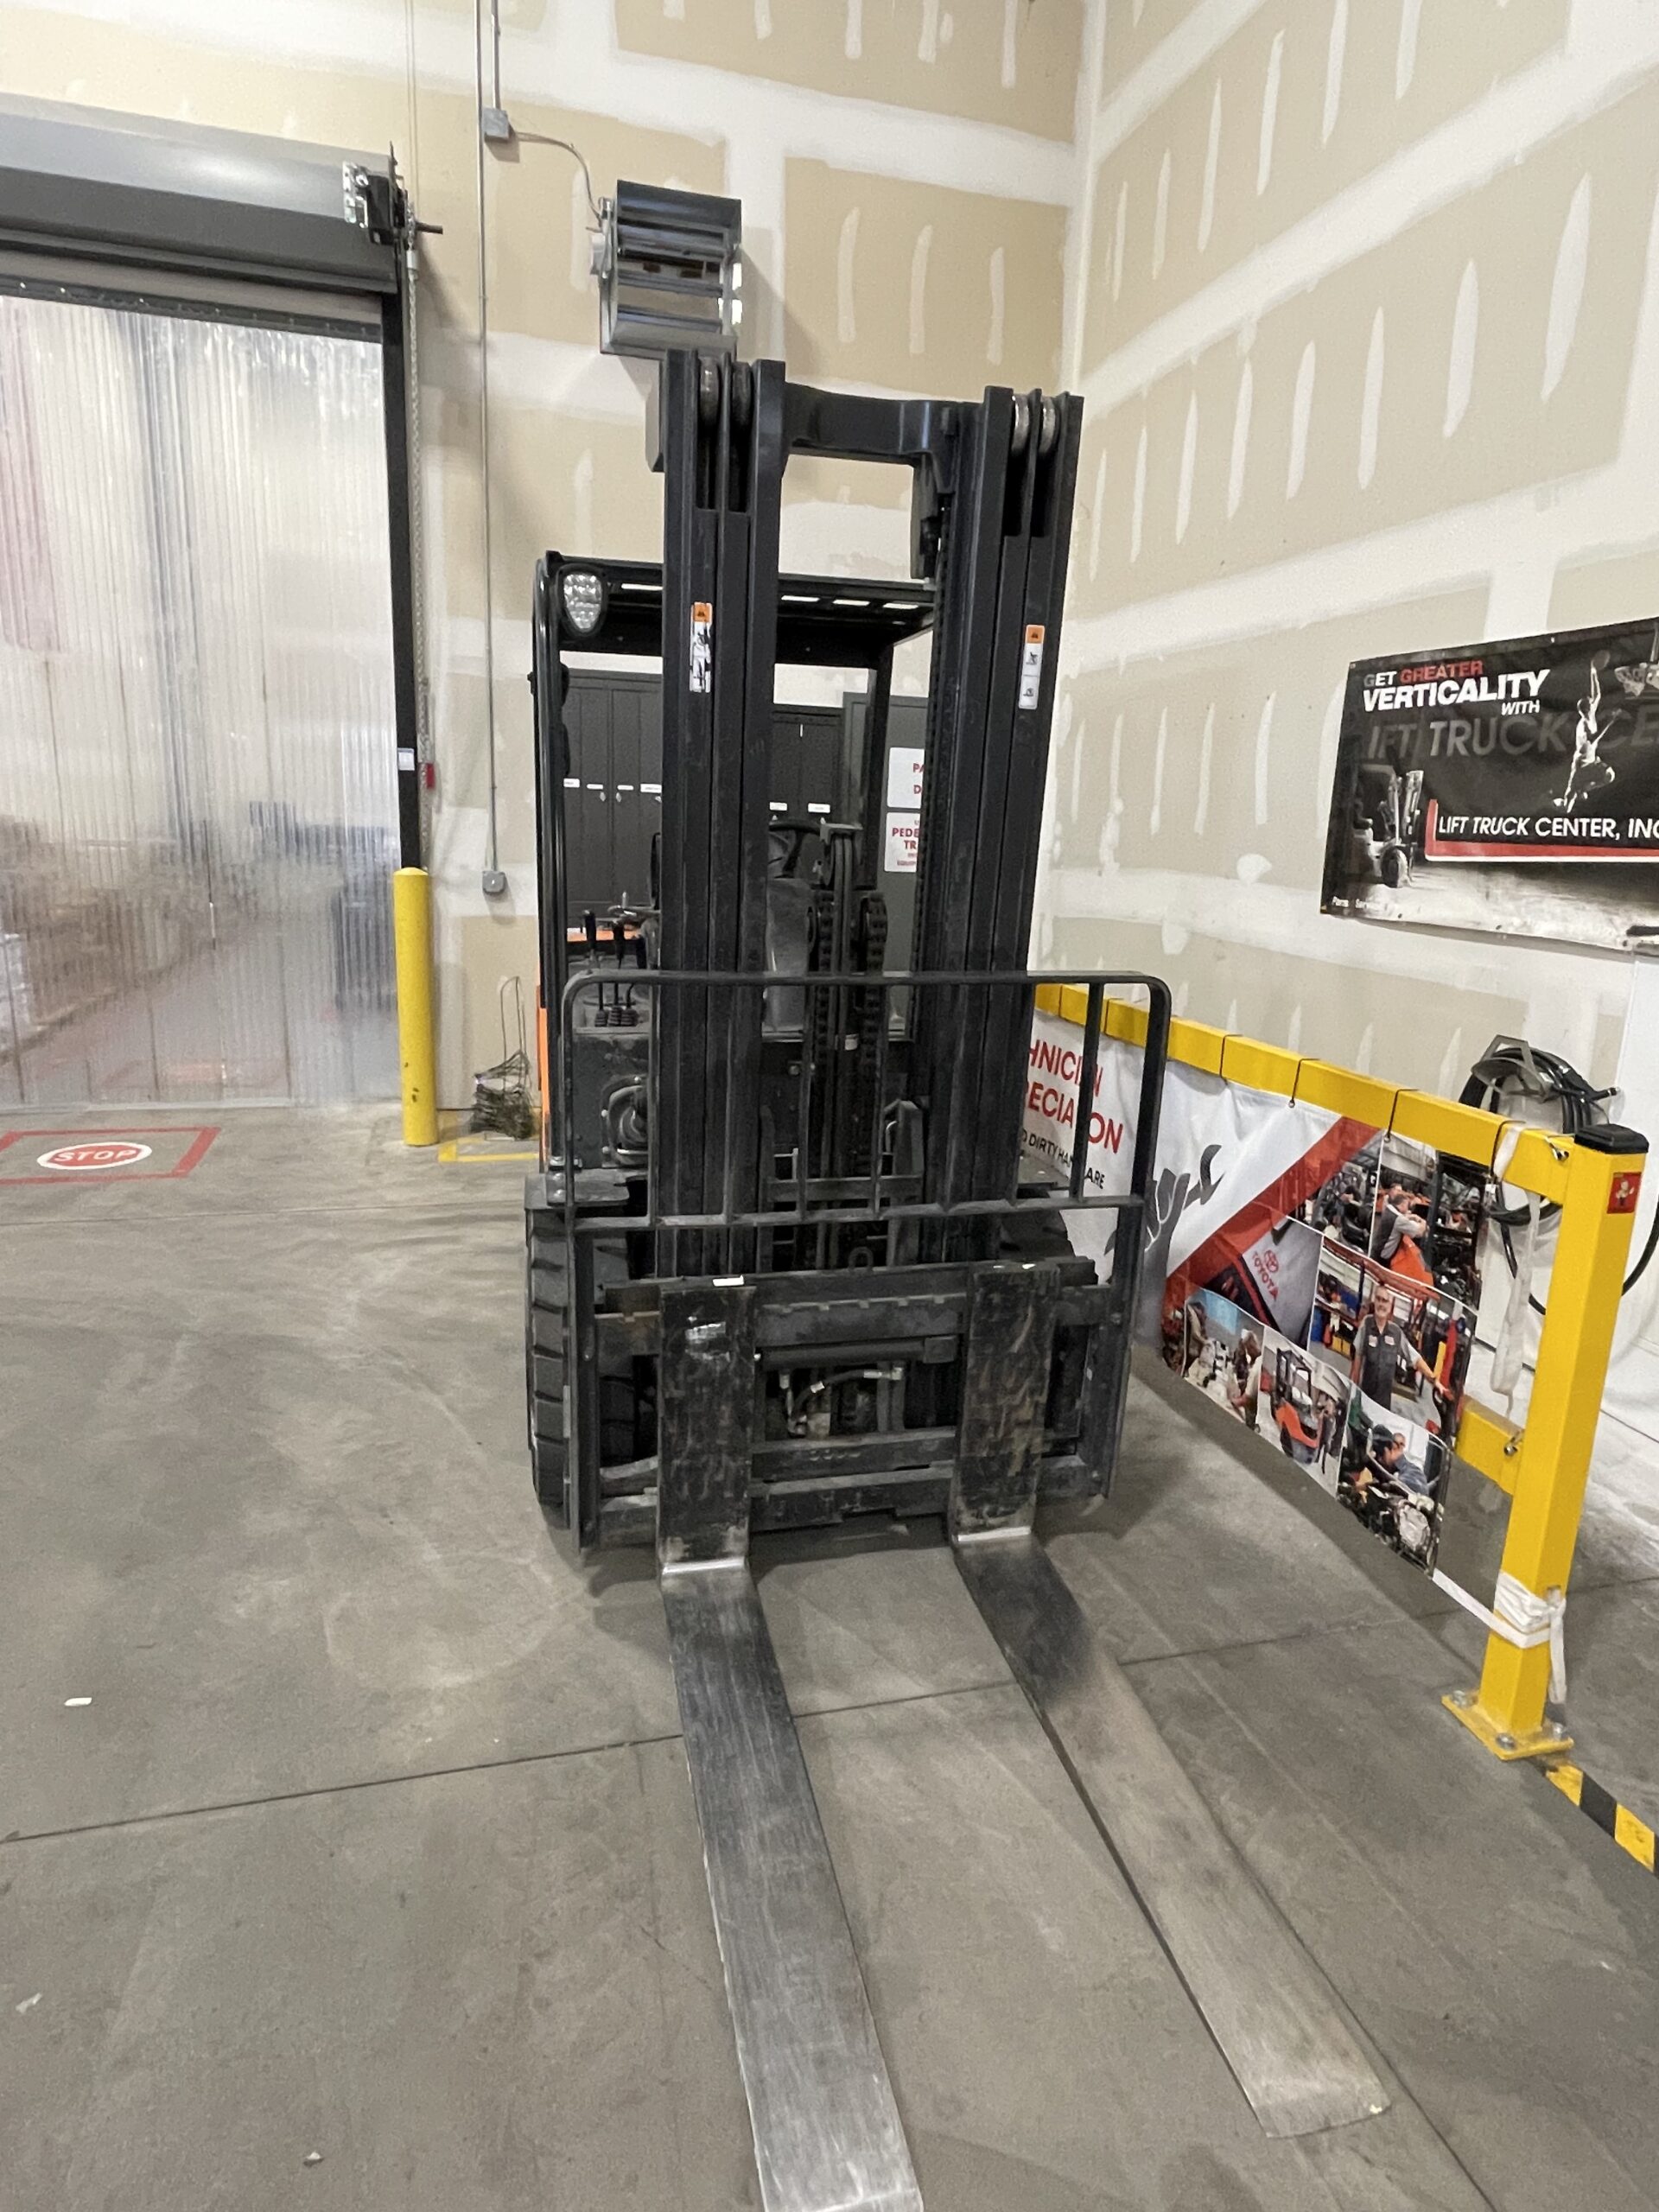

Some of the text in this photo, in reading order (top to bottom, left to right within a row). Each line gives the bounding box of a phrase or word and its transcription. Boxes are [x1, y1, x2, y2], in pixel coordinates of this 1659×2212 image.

[1363, 660, 1484, 688] GET GREATER
[1363, 669, 1551, 712] VERTICALITY
[1501, 699, 1541, 715] WITH
[1430, 711, 1570, 757] TRUCK
[1439, 816, 1470, 834] LIFT
[1472, 817, 1532, 836] TRUCK
[1535, 817, 1620, 841] CENTER,
[54, 1149, 137, 1163] STOP
[1029, 1134, 1058, 1156] DIRTY
[1252, 1250, 1279, 1302] TOYOTA
